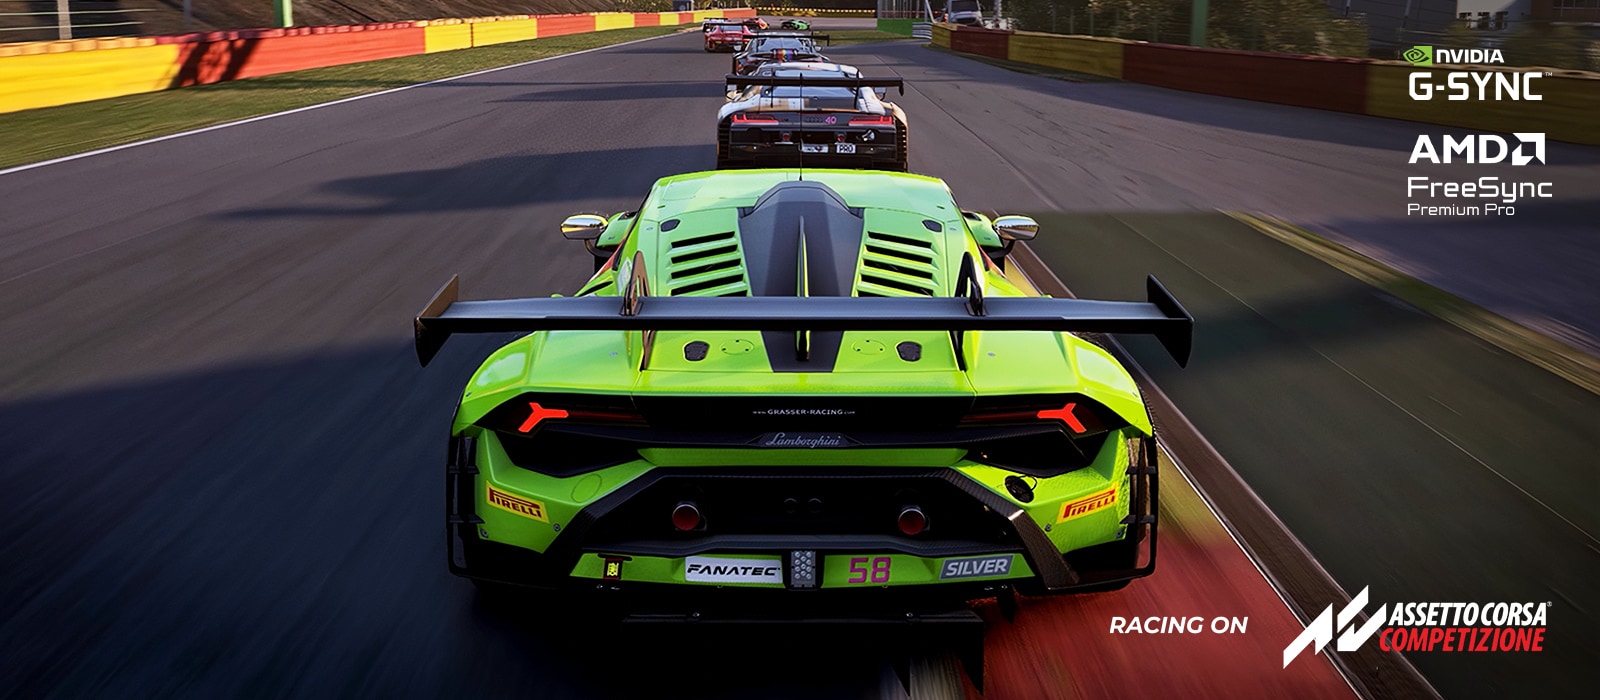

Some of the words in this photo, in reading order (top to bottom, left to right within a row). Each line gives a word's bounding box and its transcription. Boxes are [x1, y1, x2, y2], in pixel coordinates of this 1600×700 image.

[824, 116, 837, 125] 40
[839, 144, 854, 153] PRO
[765, 432, 842, 449] Lamborghini
[488, 487, 542, 518] PIRELLI
[1062, 488, 1116, 519] PIRELLI
[687, 564, 777, 576] FANATEC
[848, 556, 891, 584] 58
[945, 558, 1009, 577] SILVER
